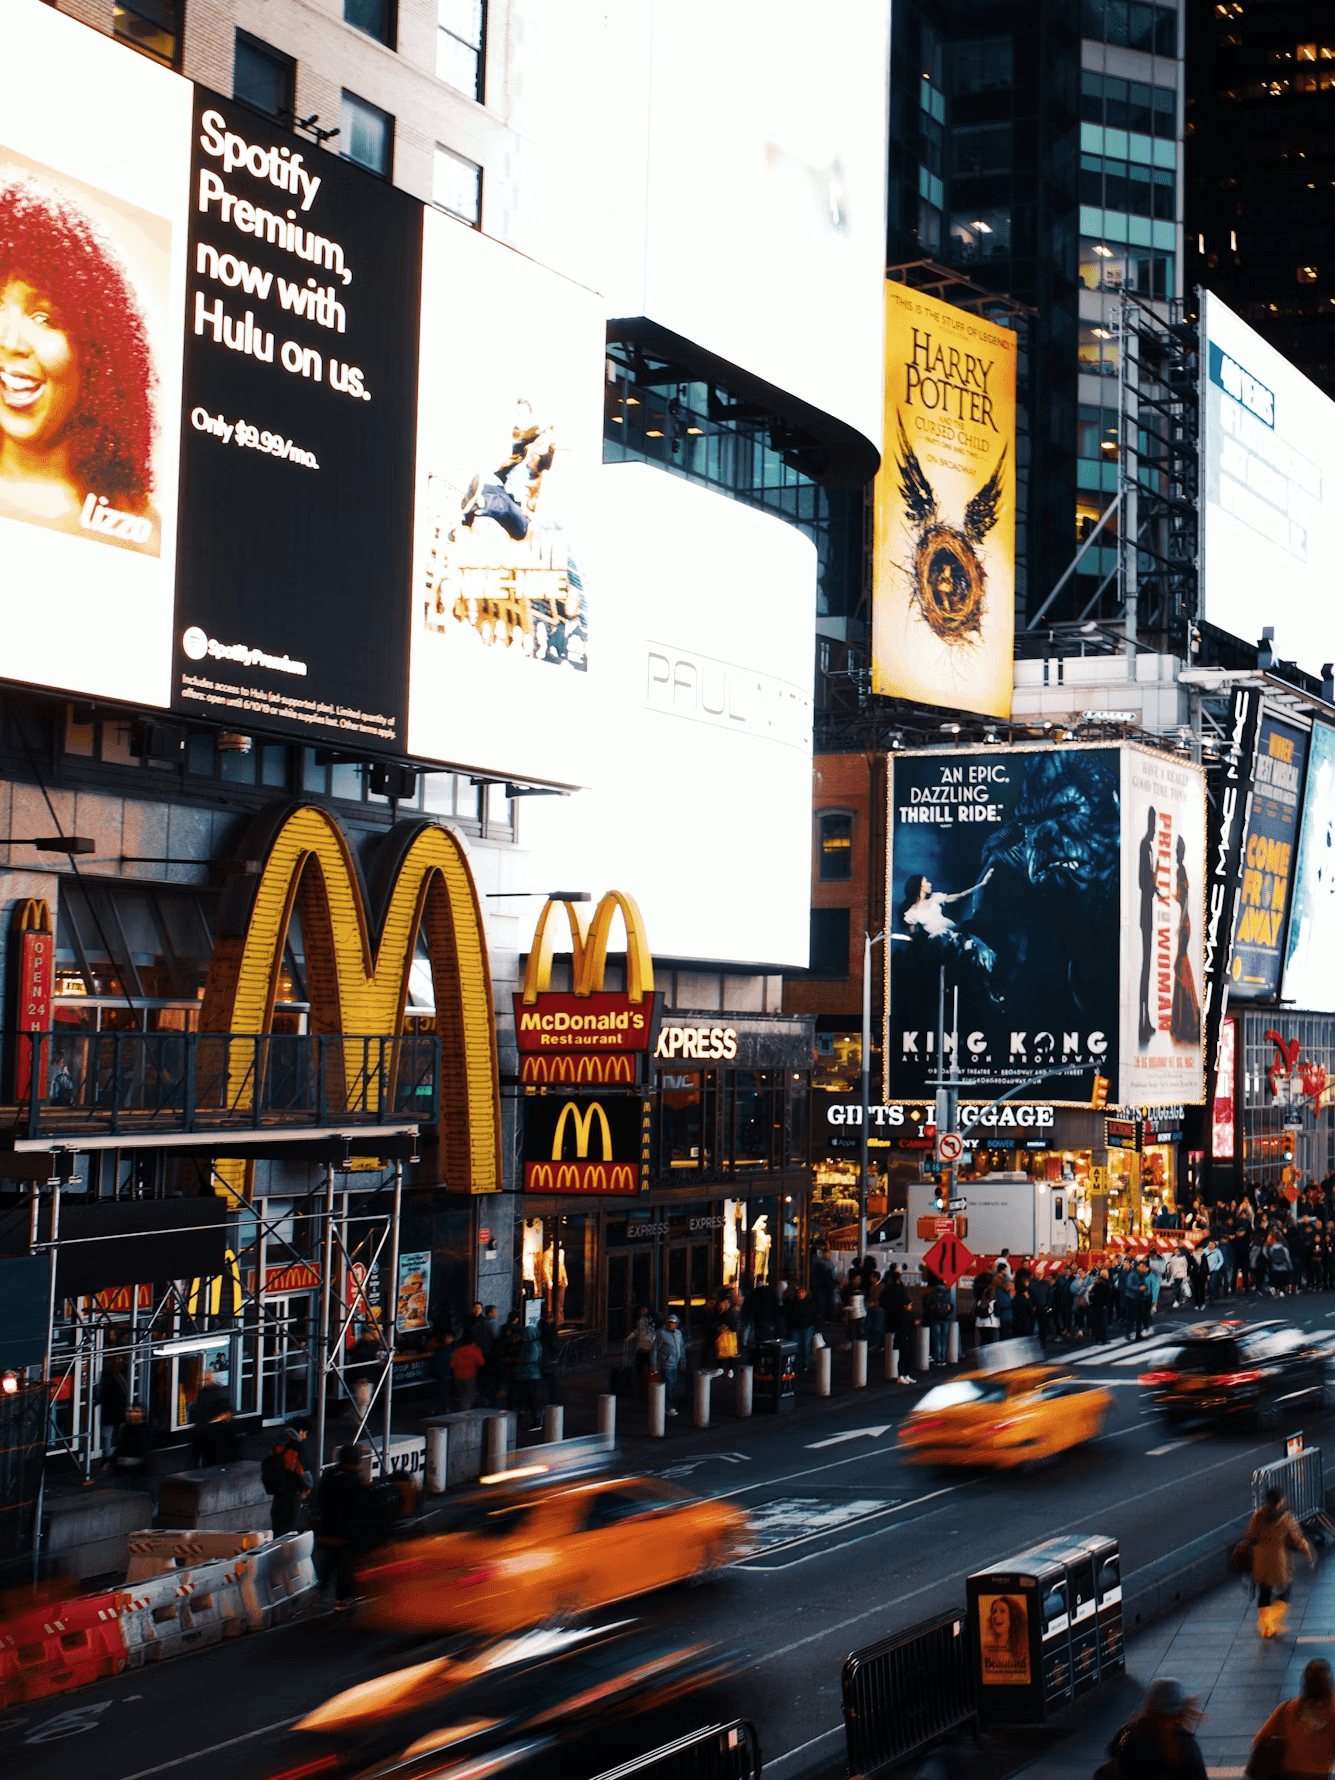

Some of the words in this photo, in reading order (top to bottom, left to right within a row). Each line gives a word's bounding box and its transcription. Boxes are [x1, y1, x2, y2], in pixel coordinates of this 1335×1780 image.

[200, 109, 322, 211] Spotify
[197, 168, 353, 285] Premium,
[196, 242, 272, 300] now
[277, 278, 347, 333] with
[194, 291, 273, 363] Hulu
[281, 341, 323, 381] on
[330, 365, 371, 401] us.
[911, 327, 994, 395] HARRY
[905, 362, 999, 433] POTTER
[191, 407, 235, 443] Only
[235, 420, 320, 470] $9.99/mo.
[914, 415, 956, 441] CURSED
[957, 430, 990, 452] CHILD
[647, 651, 747, 723] PAUL
[910, 785, 990, 804] DAZZLING
[899, 805, 954, 824] THRILL
[1156, 812, 1172, 908] PRETTY
[1246, 833, 1292, 879] COME
[1241, 868, 1288, 912] FROM
[1236, 906, 1284, 948] AWAY
[32, 942, 45, 998] OPEN
[1157, 927, 1173, 1032] WOMAN
[28, 1003, 45, 1016] 24
[520, 1011, 645, 1031] McDonald's
[540, 1033, 623, 1045] Restaurant
[902, 1031, 988, 1054] KING
[1010, 1031, 1109, 1054] KONG
[970, 1054, 992, 1063] ON
[1009, 1054, 1107, 1064] BROADWAY
[838, 1139, 856, 1147] Apple
[898, 1138, 934, 1148] Canon
[987, 1138, 1016, 1148] BOWER
[1093, 1168, 1101, 1190] ATM
[628, 1223, 669, 1238] EXPRESS
[689, 1215, 726, 1231] EXPRESS
[390, 1449, 420, 1475] YPD
[985, 1657, 1027, 1669] Beautiful
